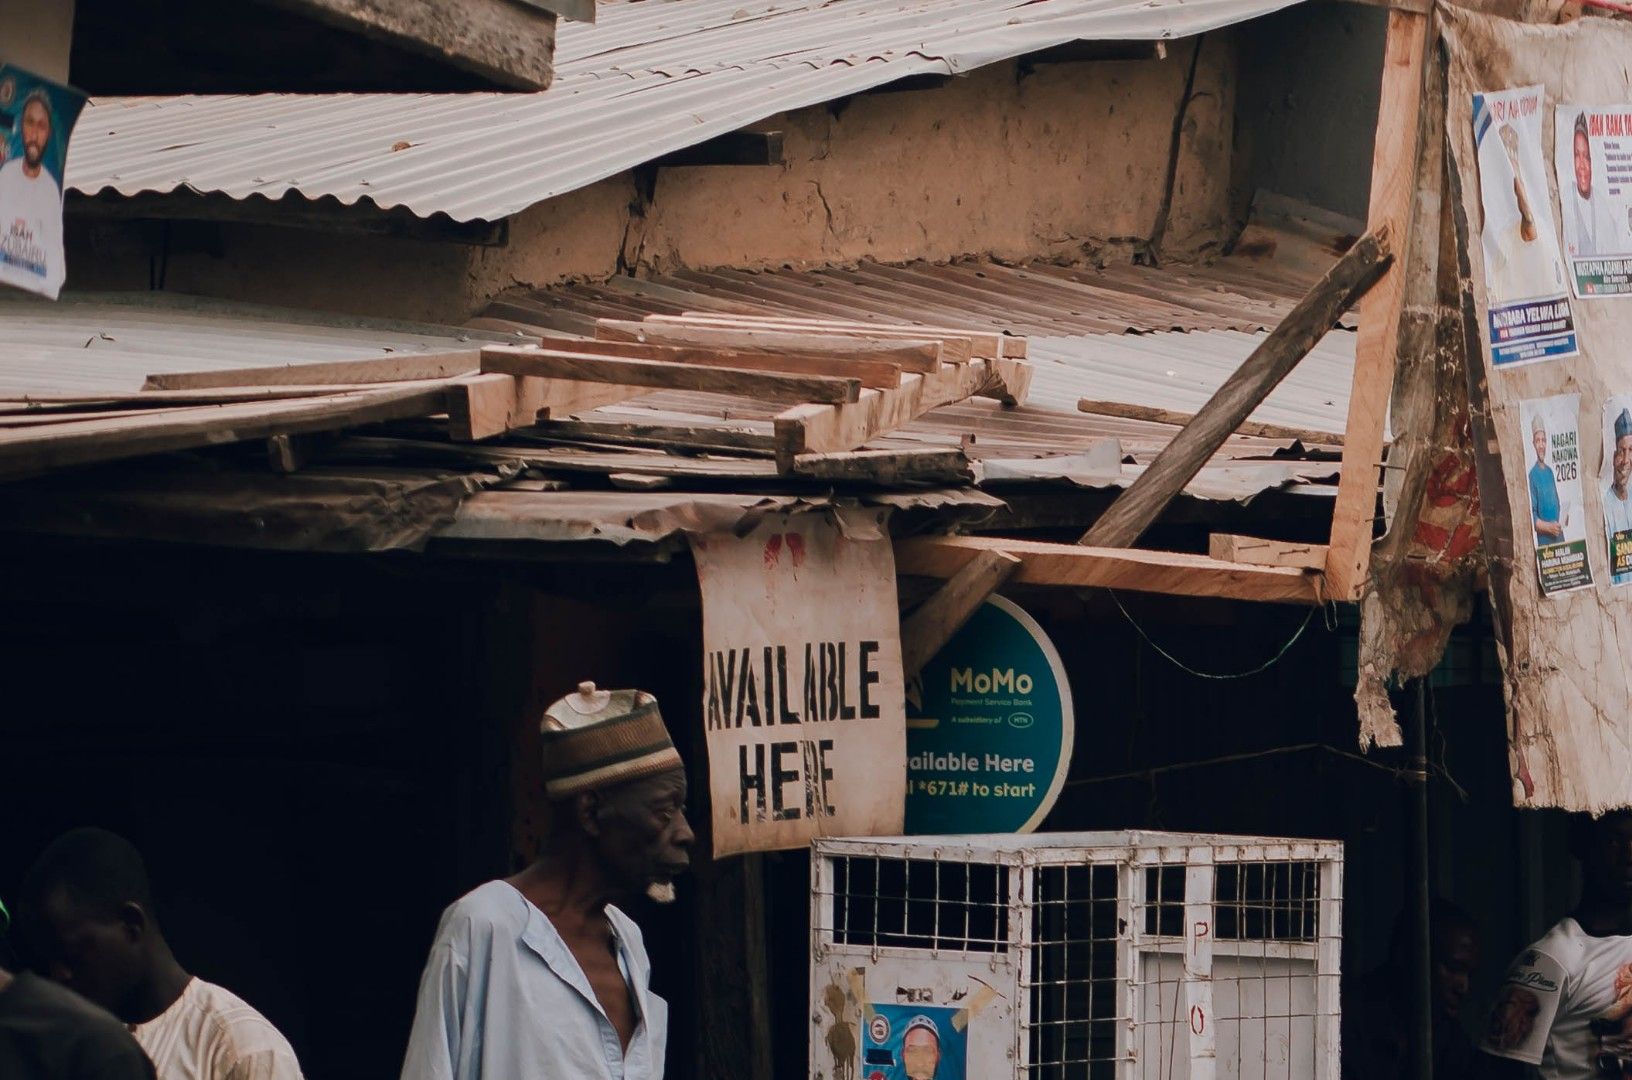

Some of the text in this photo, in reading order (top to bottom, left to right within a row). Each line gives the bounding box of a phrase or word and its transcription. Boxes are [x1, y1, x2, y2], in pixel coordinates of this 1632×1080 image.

[1552, 431, 1577, 448] NAGARI
[1552, 447, 1578, 463] NAKOWA
[1556, 463, 1577, 482] 2026
[708, 641, 880, 731] AVAILABLE
[950, 667, 1033, 693] MoMo
[951, 698, 1033, 707] Payment Service Bank
[985, 753, 1035, 773] Here
[972, 782, 990, 797] to
[993, 782, 1036, 798] start
